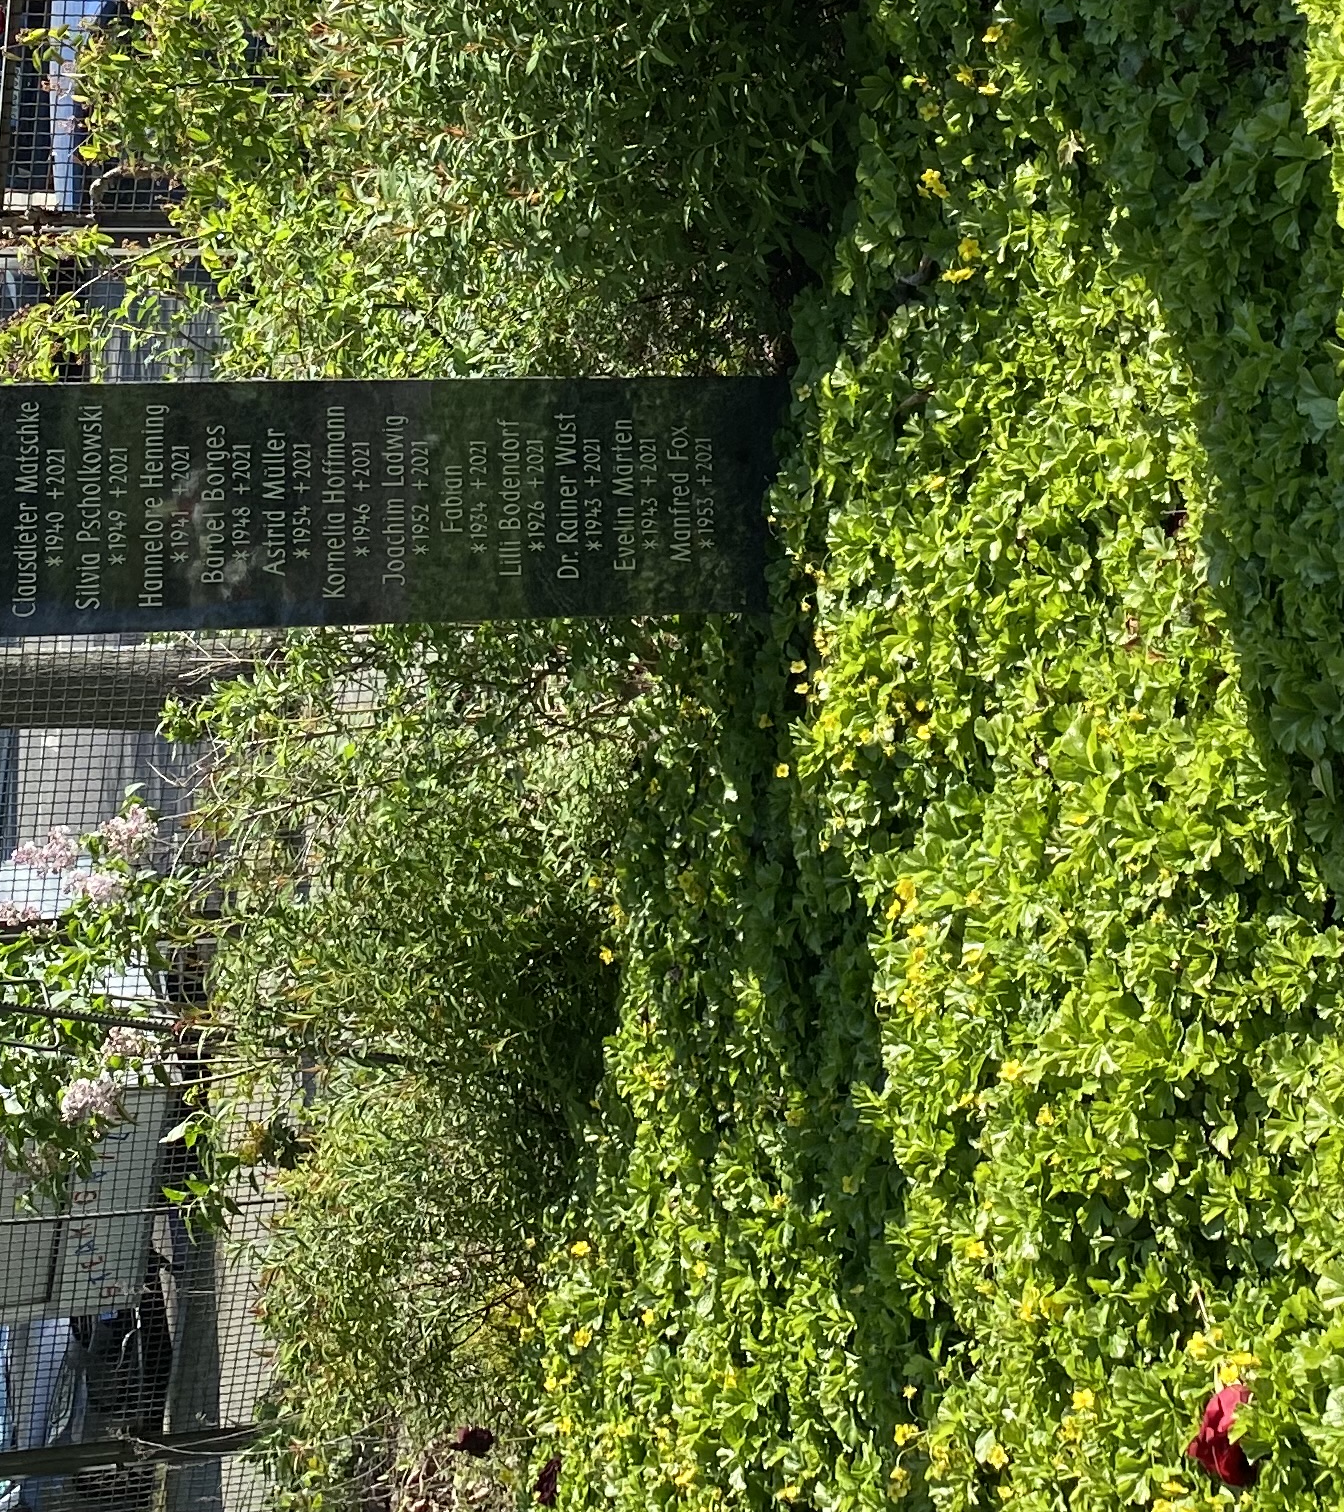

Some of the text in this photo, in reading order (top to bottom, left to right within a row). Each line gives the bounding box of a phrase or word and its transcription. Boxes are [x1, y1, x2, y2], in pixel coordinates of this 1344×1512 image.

[12, 401, 40, 617] Clausdieter Matschke
[75, 405, 103, 609] Silvia Pscholkowski
[139, 404, 170, 606] Hannelore Henning
[201, 425, 231, 501] Borges
[262, 428, 286, 576] Astrid Müller
[322, 406, 346, 597] Kornelia Hoffmann
[382, 415, 409, 585] Joachim Ladwig
[441, 465, 463, 532] Fabian
[497, 418, 522, 575] Lilli Bodendorf
[554, 413, 579, 578] Dr. Rainer Wüst
[611, 419, 636, 570] Evelin Märten
[667, 426, 692, 561] Manfred Fox
